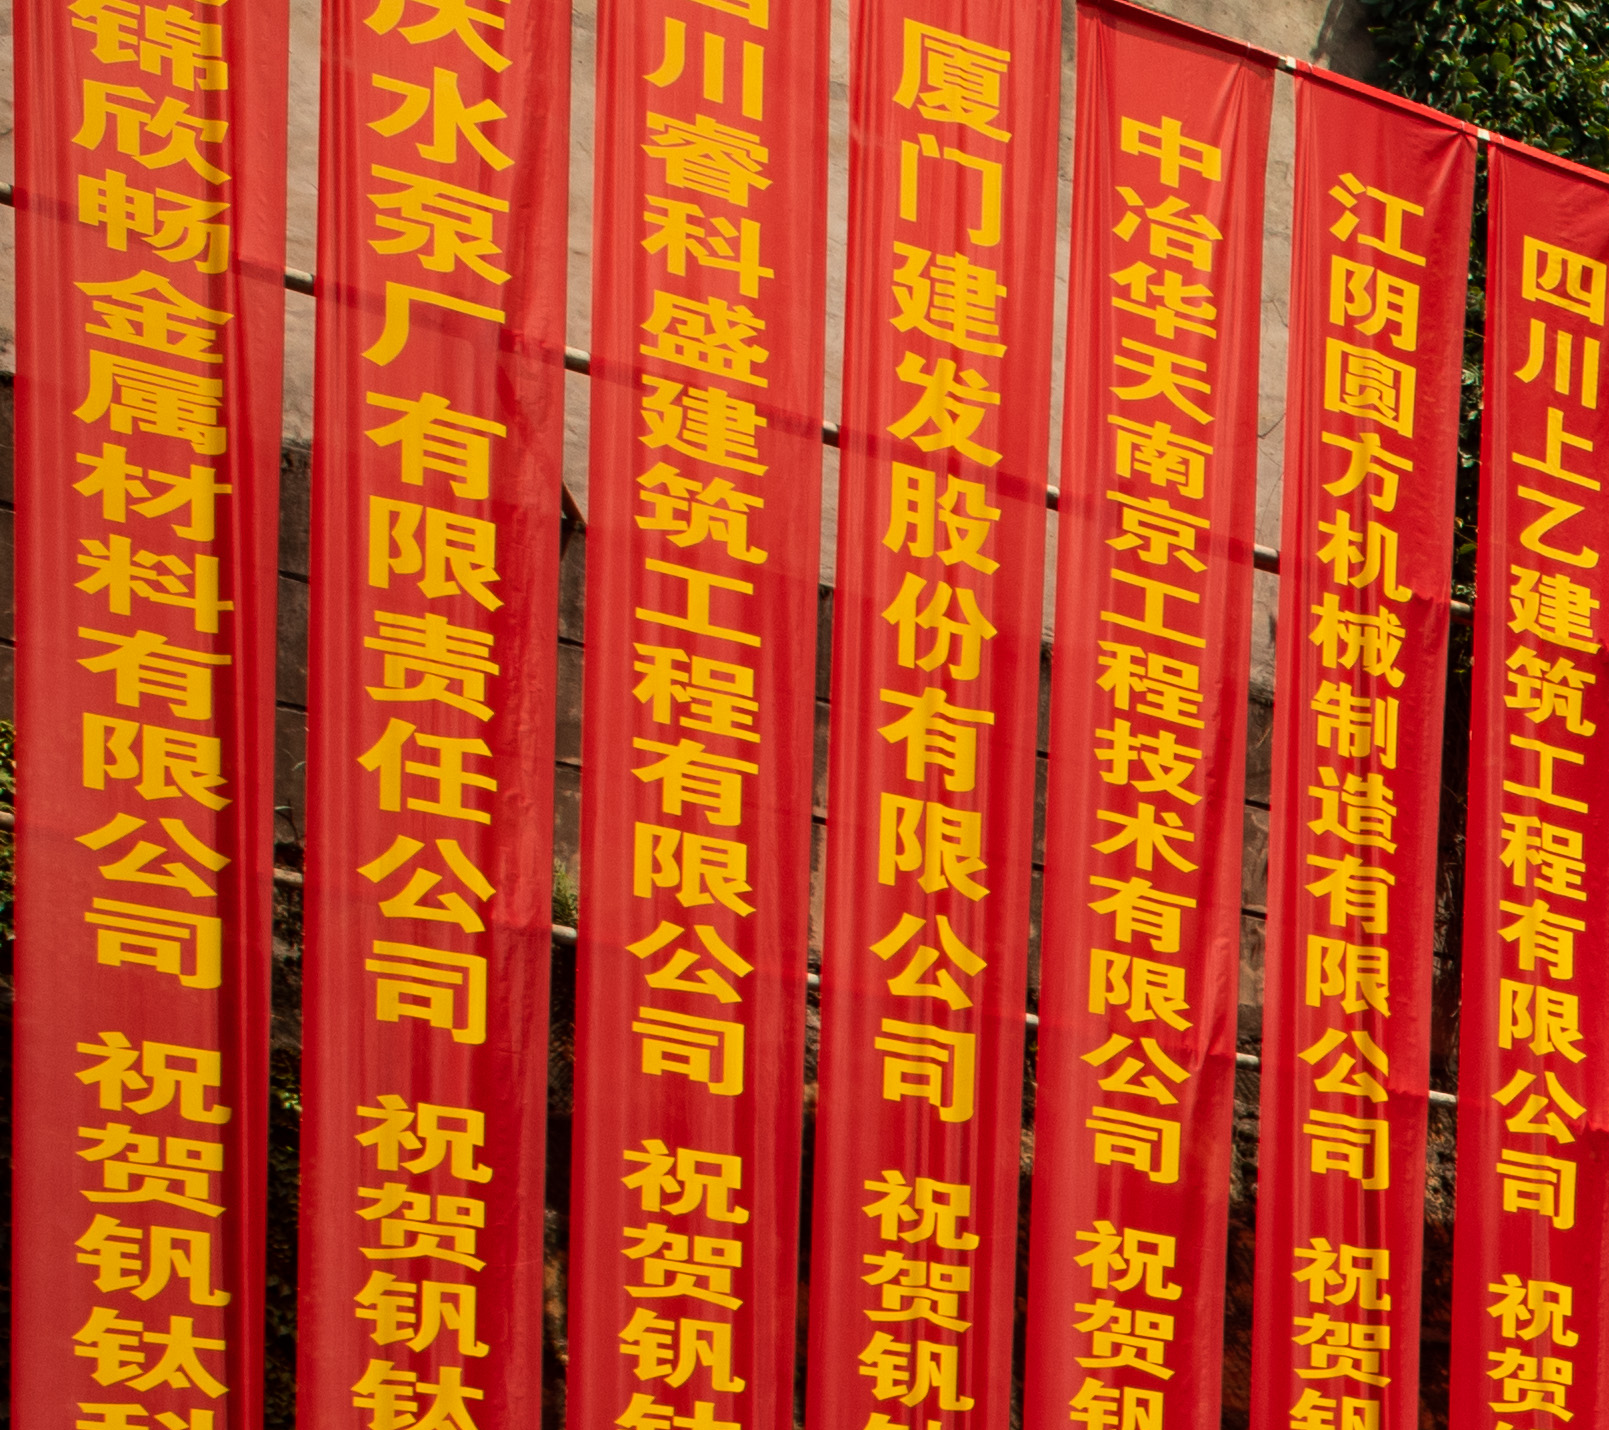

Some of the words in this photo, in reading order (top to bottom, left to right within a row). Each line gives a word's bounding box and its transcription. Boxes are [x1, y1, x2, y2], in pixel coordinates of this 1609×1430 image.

[870, 18, 1011, 1122] 厦门建发股份有限公司
[1081, 117, 1222, 1184] 中冶华天南京工程技术有限公司
[1299, 173, 1426, 1189] 江阴圆方机械制造有限公司
[1492, 236, 1607, 1229] 四川上乙建筑工程有限公司
